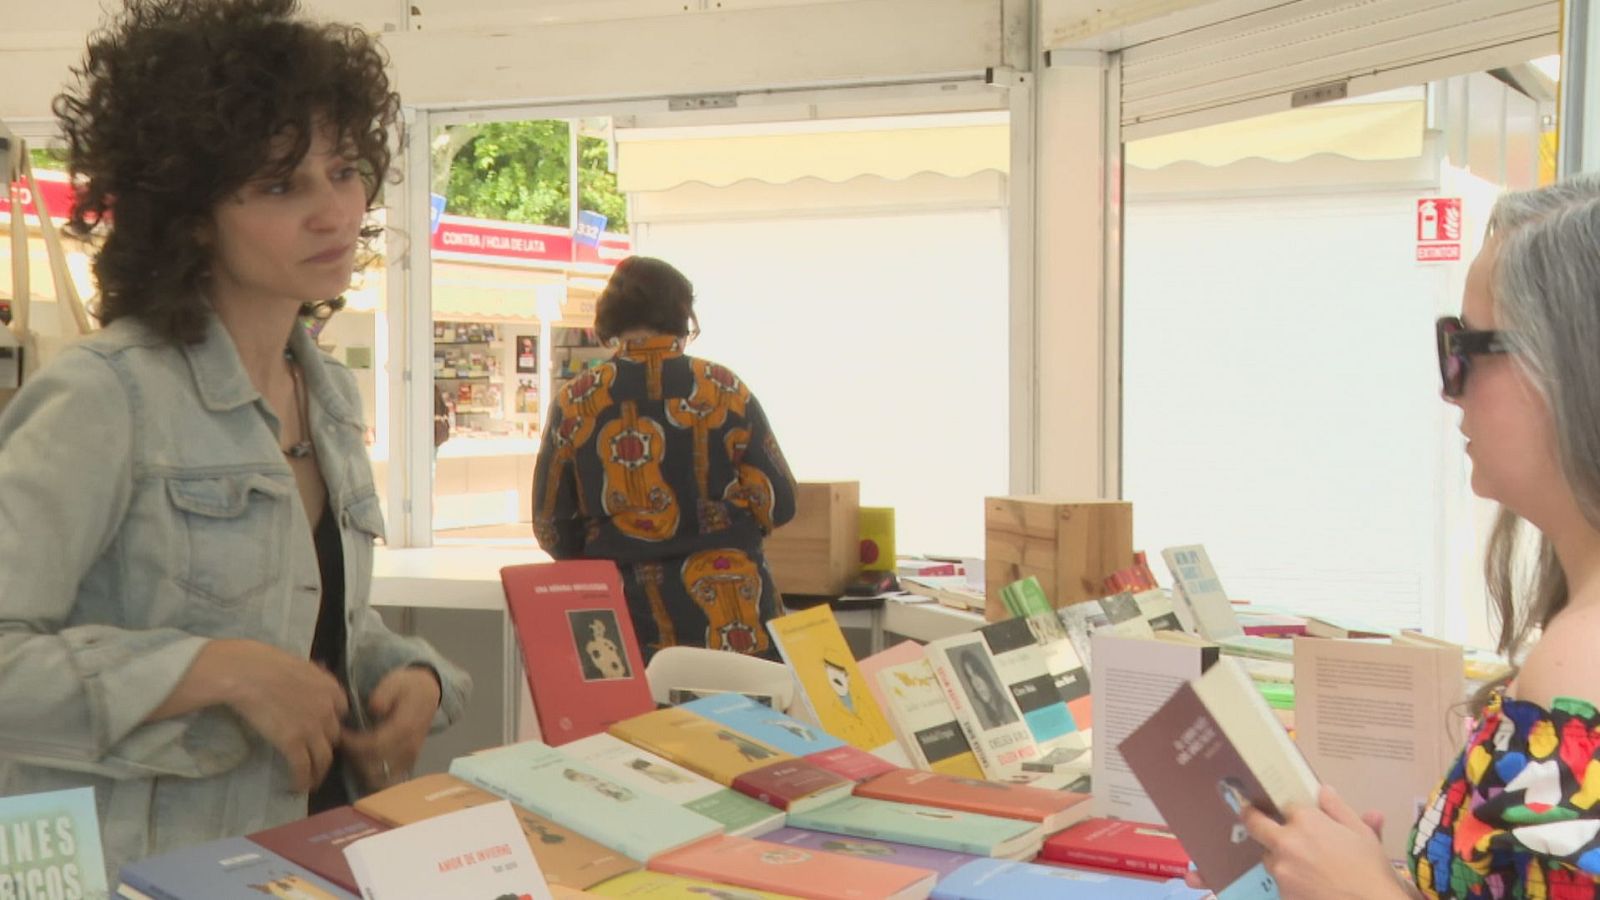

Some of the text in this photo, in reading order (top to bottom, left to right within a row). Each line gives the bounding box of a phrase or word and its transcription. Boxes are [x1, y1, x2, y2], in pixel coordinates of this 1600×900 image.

[442, 231, 480, 248] CONTRA
[486, 234, 510, 249] HOJA
[511, 237, 522, 251] DE
[522, 238, 546, 252] LATA
[438, 844, 512, 873] AMOR DE INVIERNO
